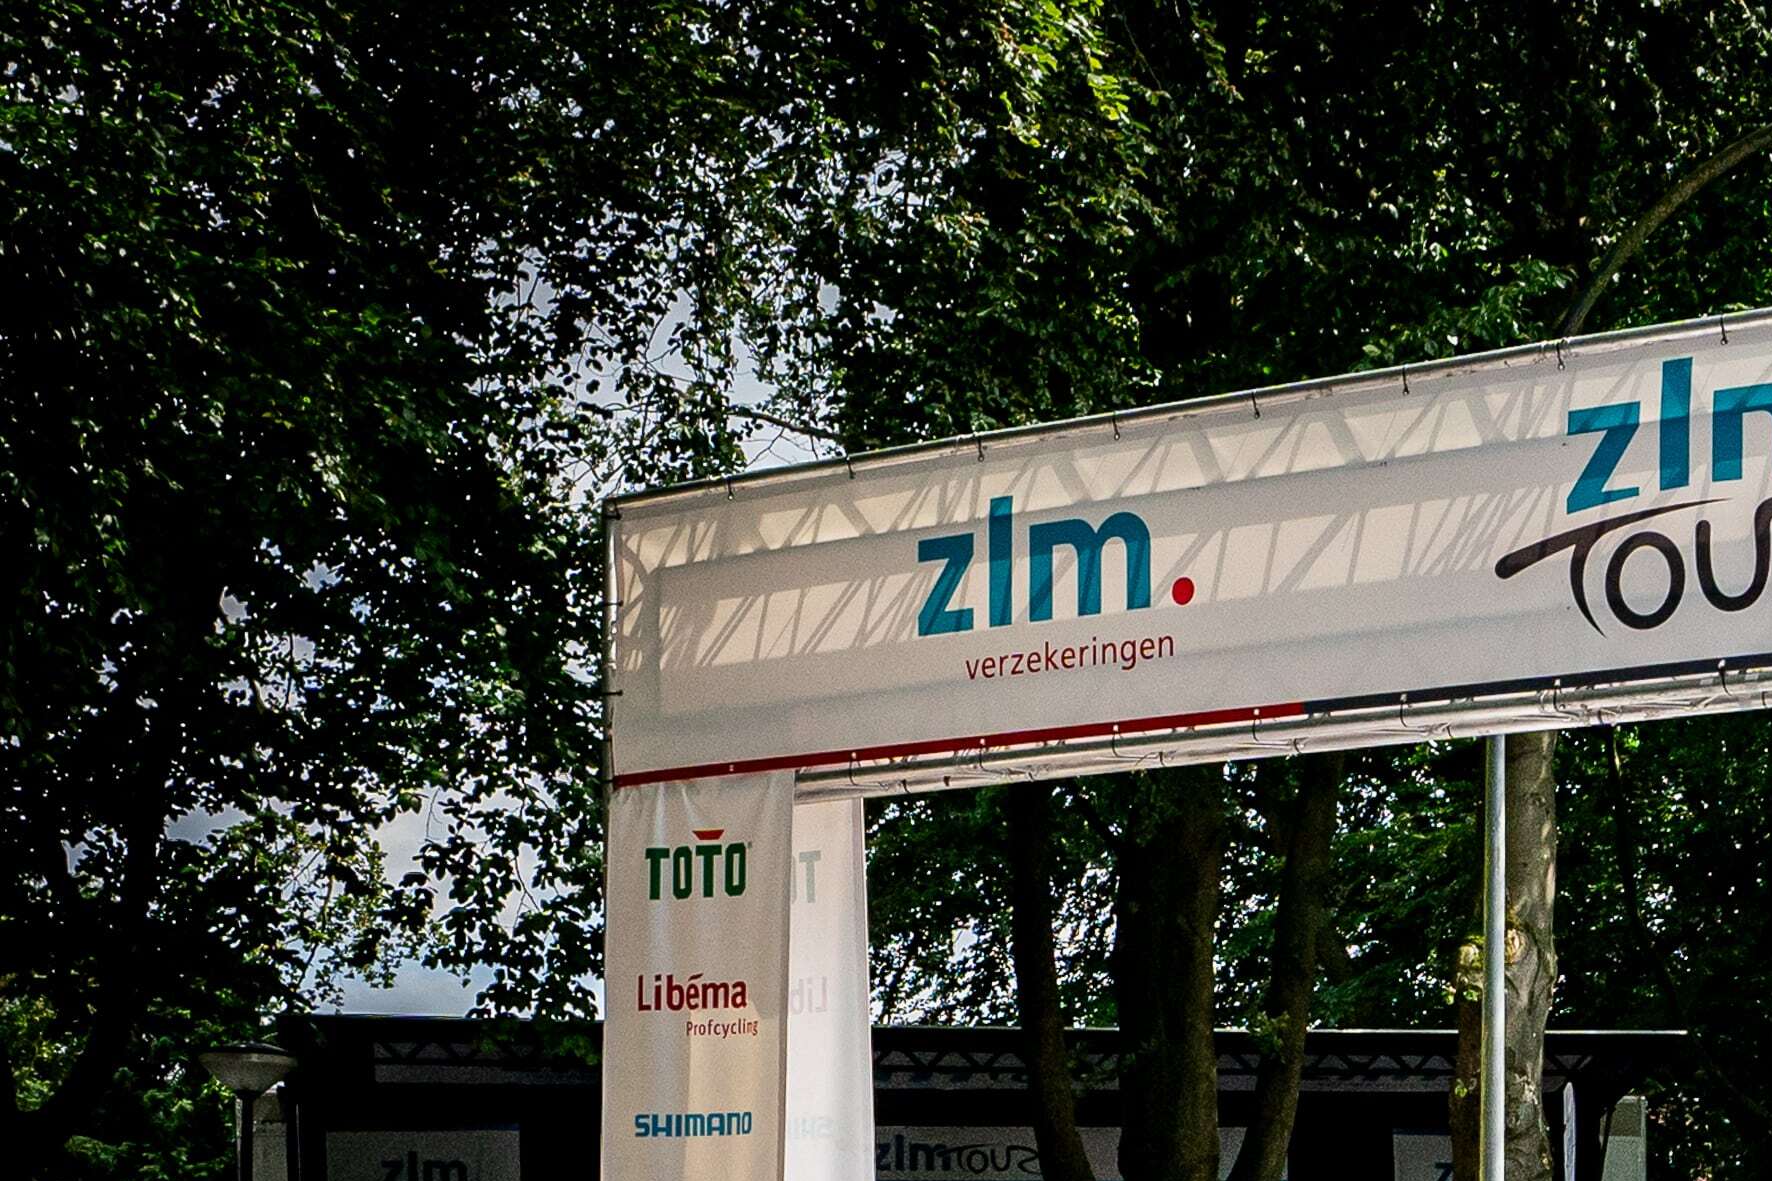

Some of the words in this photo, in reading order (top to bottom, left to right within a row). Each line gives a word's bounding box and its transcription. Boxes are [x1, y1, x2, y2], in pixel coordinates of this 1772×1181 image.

[965, 634, 1175, 680] verzekeringen
[644, 842, 747, 900] TOTO
[637, 972, 748, 1013] Libéma
[686, 1018, 759, 1040] Profcycling
[634, 1111, 753, 1138] SHIMANO
